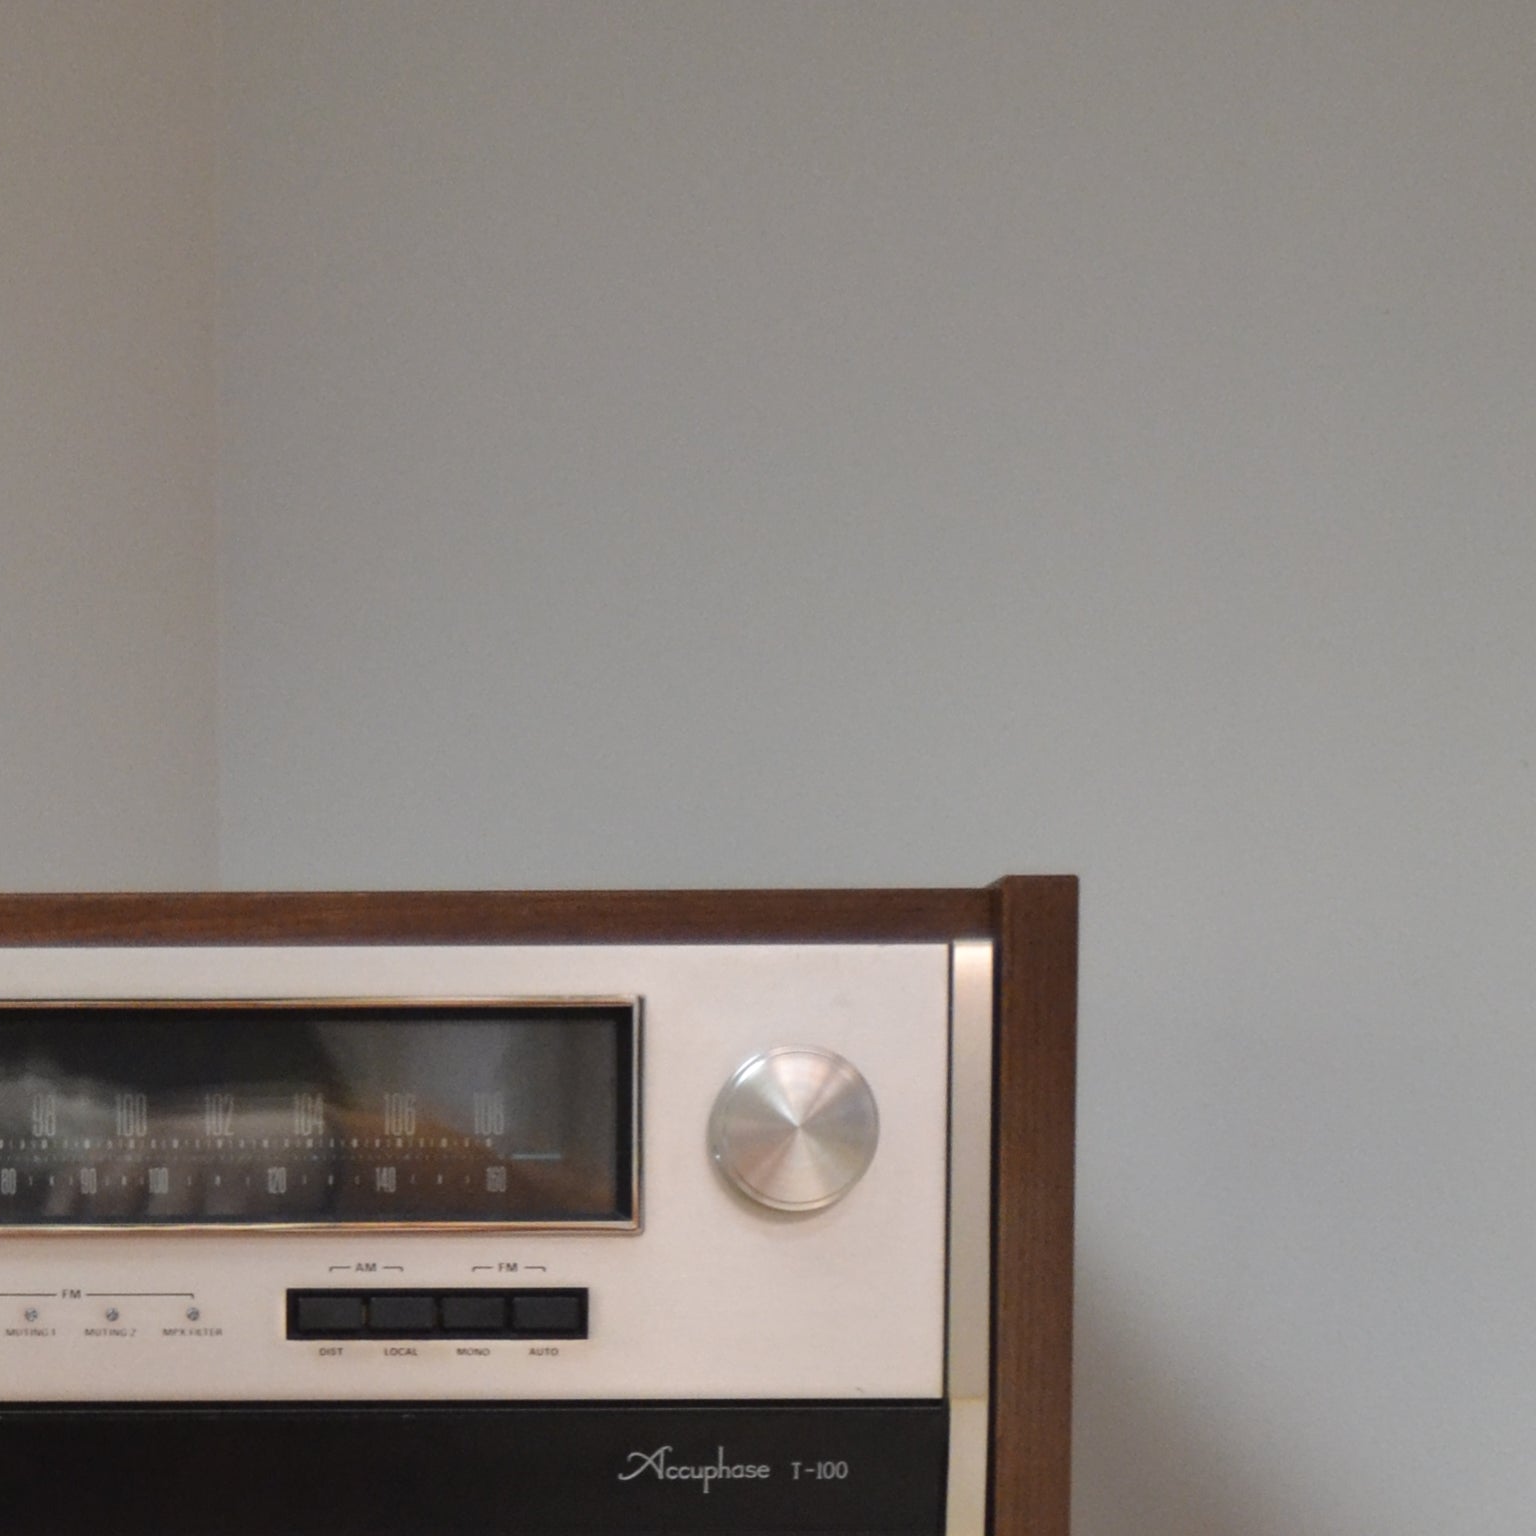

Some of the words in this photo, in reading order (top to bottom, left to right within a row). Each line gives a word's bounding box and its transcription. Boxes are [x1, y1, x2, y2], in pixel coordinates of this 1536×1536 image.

[33, 1094, 56, 1137] 98
[355, 1263, 377, 1272] AM
[499, 1263, 518, 1272] FM
[62, 1289, 81, 1299] FM
[320, 1348, 342, 1356] DIST
[384, 1348, 418, 1356] LOCAL
[457, 1348, 489, 1356] MONO
[529, 1348, 559, 1356] AUTO
[618, 1445, 771, 1494] Accuphase
[791, 1461, 848, 1480] T-100
